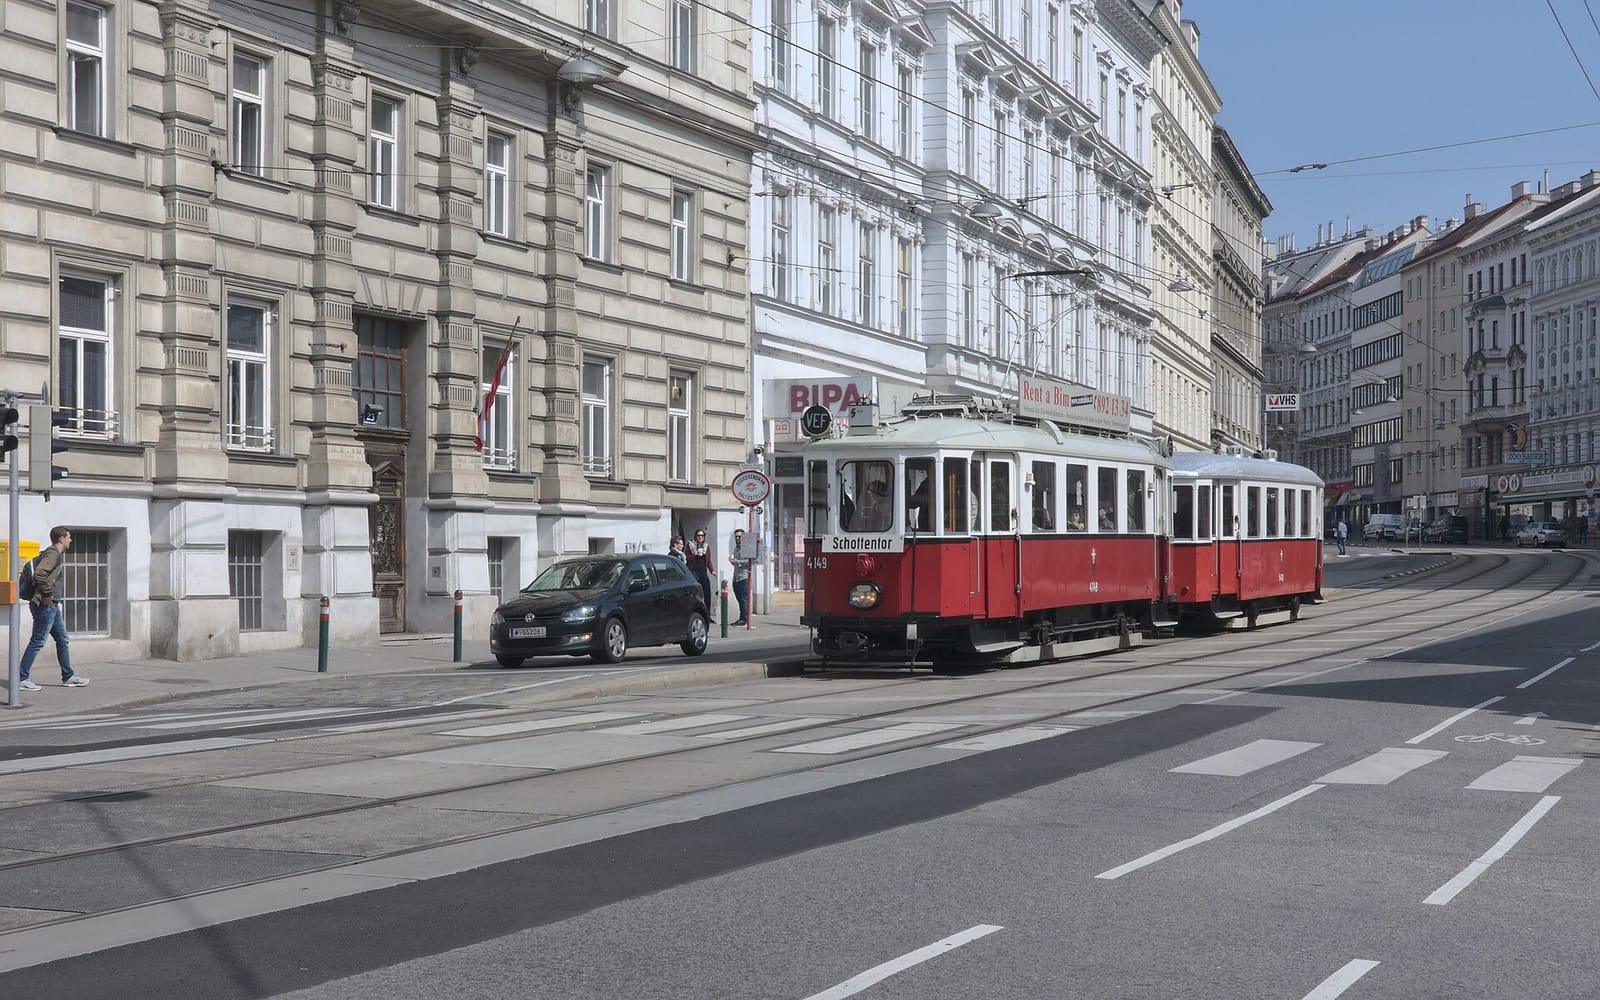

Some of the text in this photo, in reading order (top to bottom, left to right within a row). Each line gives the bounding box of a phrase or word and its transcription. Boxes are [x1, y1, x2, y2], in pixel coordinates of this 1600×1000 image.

[790, 383, 861, 413] BIPA
[1023, 380, 1042, 402] Rent
[1045, 389, 1051, 404] a
[1053, 386, 1070, 408] Bim
[1279, 395, 1296, 405] VHS
[1096, 394, 1109, 415] 892
[1111, 398, 1119, 417] 13
[1120, 400, 1129, 418] 34
[805, 412, 829, 428] VEF
[832, 536, 893, 550] Schottentor
[806, 556, 828, 569] 4149
